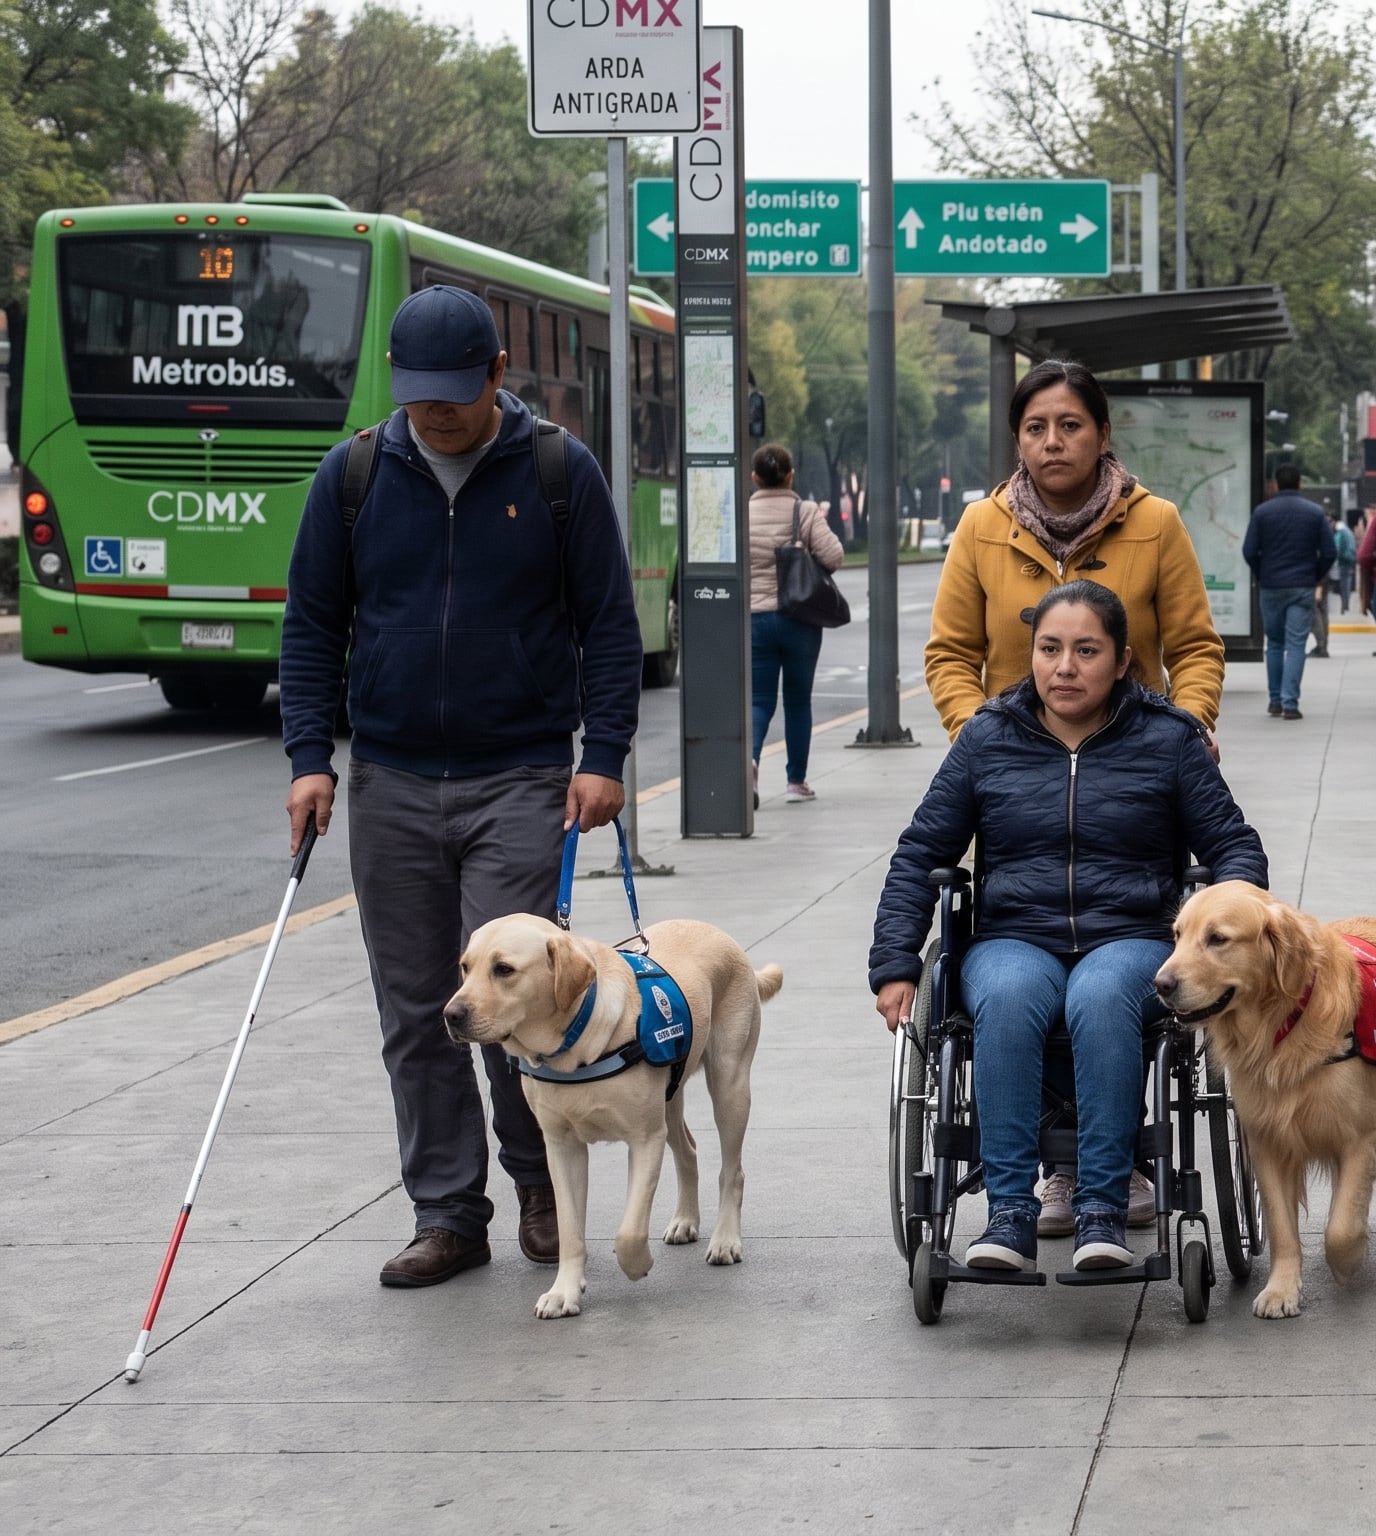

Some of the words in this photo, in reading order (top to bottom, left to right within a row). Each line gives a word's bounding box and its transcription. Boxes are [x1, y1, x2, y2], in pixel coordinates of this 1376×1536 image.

[547, 0, 683, 28] CDMX
[585, 57, 645, 79] ARDA
[552, 92, 679, 115] ANTIGRADA
[745, 218, 821, 238] onchar
[684, 247, 730, 261] CDMX
[938, 234, 1048, 254] Andotado
[199, 247, 233, 279] 10
[746, 249, 819, 270] mpero
[177, 305, 244, 347] MB
[133, 356, 295, 387] Metrobús.
[147, 490, 267, 524] CDMX
